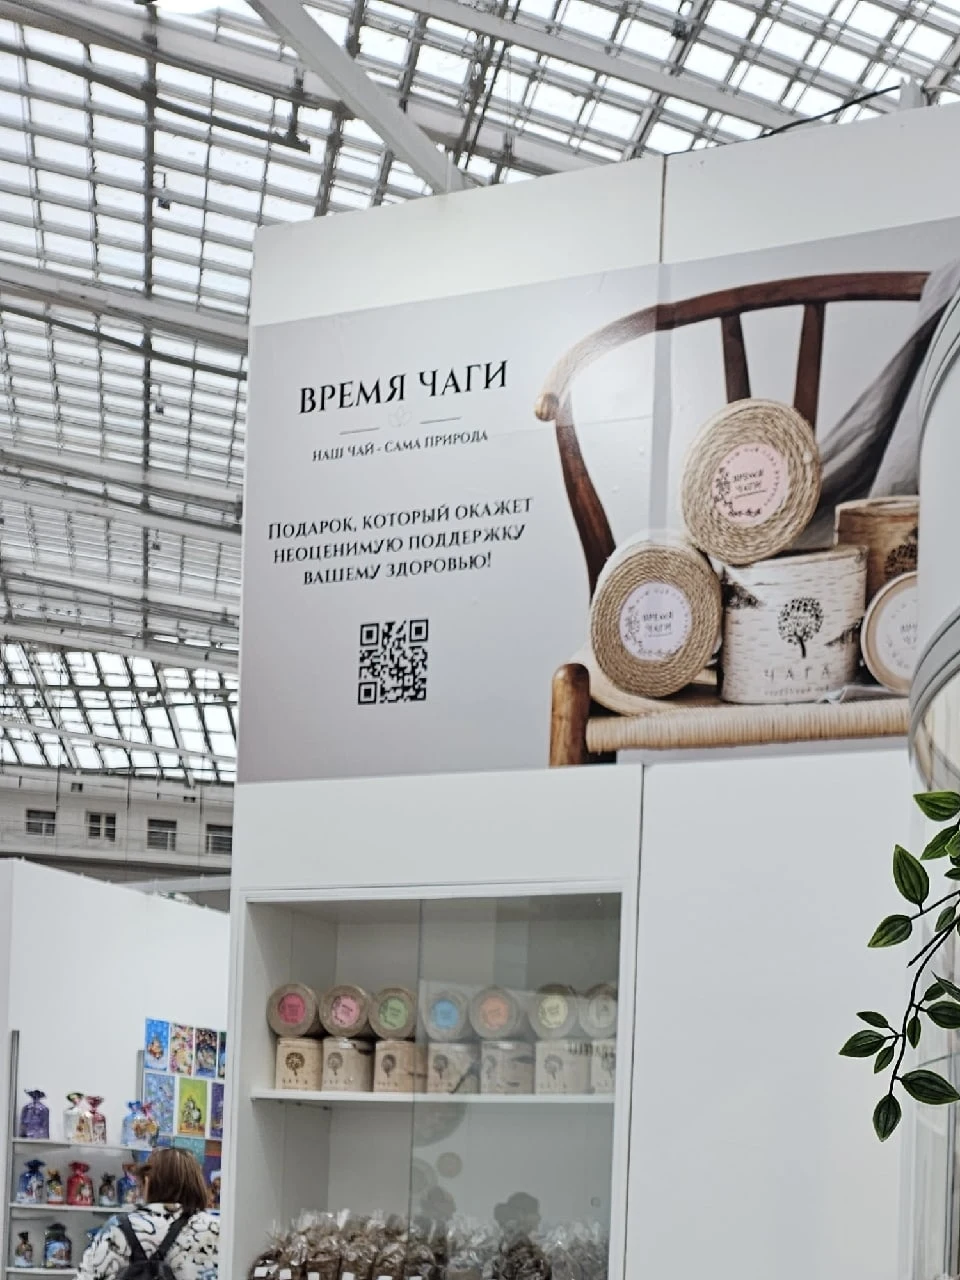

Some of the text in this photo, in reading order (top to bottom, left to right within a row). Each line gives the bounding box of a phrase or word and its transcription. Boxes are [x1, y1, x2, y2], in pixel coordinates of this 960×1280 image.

[299, 360, 508, 414] ВРЕМЯ ЧАГИ
[312, 446, 344, 461] НАШ
[348, 441, 375, 457] ЧАЙ
[384, 437, 421, 454] САМА
[424, 430, 488, 449] ПРИРОДА
[268, 497, 534, 540] ПОДАРОК, КОТОРЫЙ ОКАЖЕТ
[273, 524, 525, 564] НЕОЦЕНИМУЮ ПОДДЕРЖКУ
[303, 552, 492, 585] ВАШЕМУ ЗДОРОВЬЮ!
